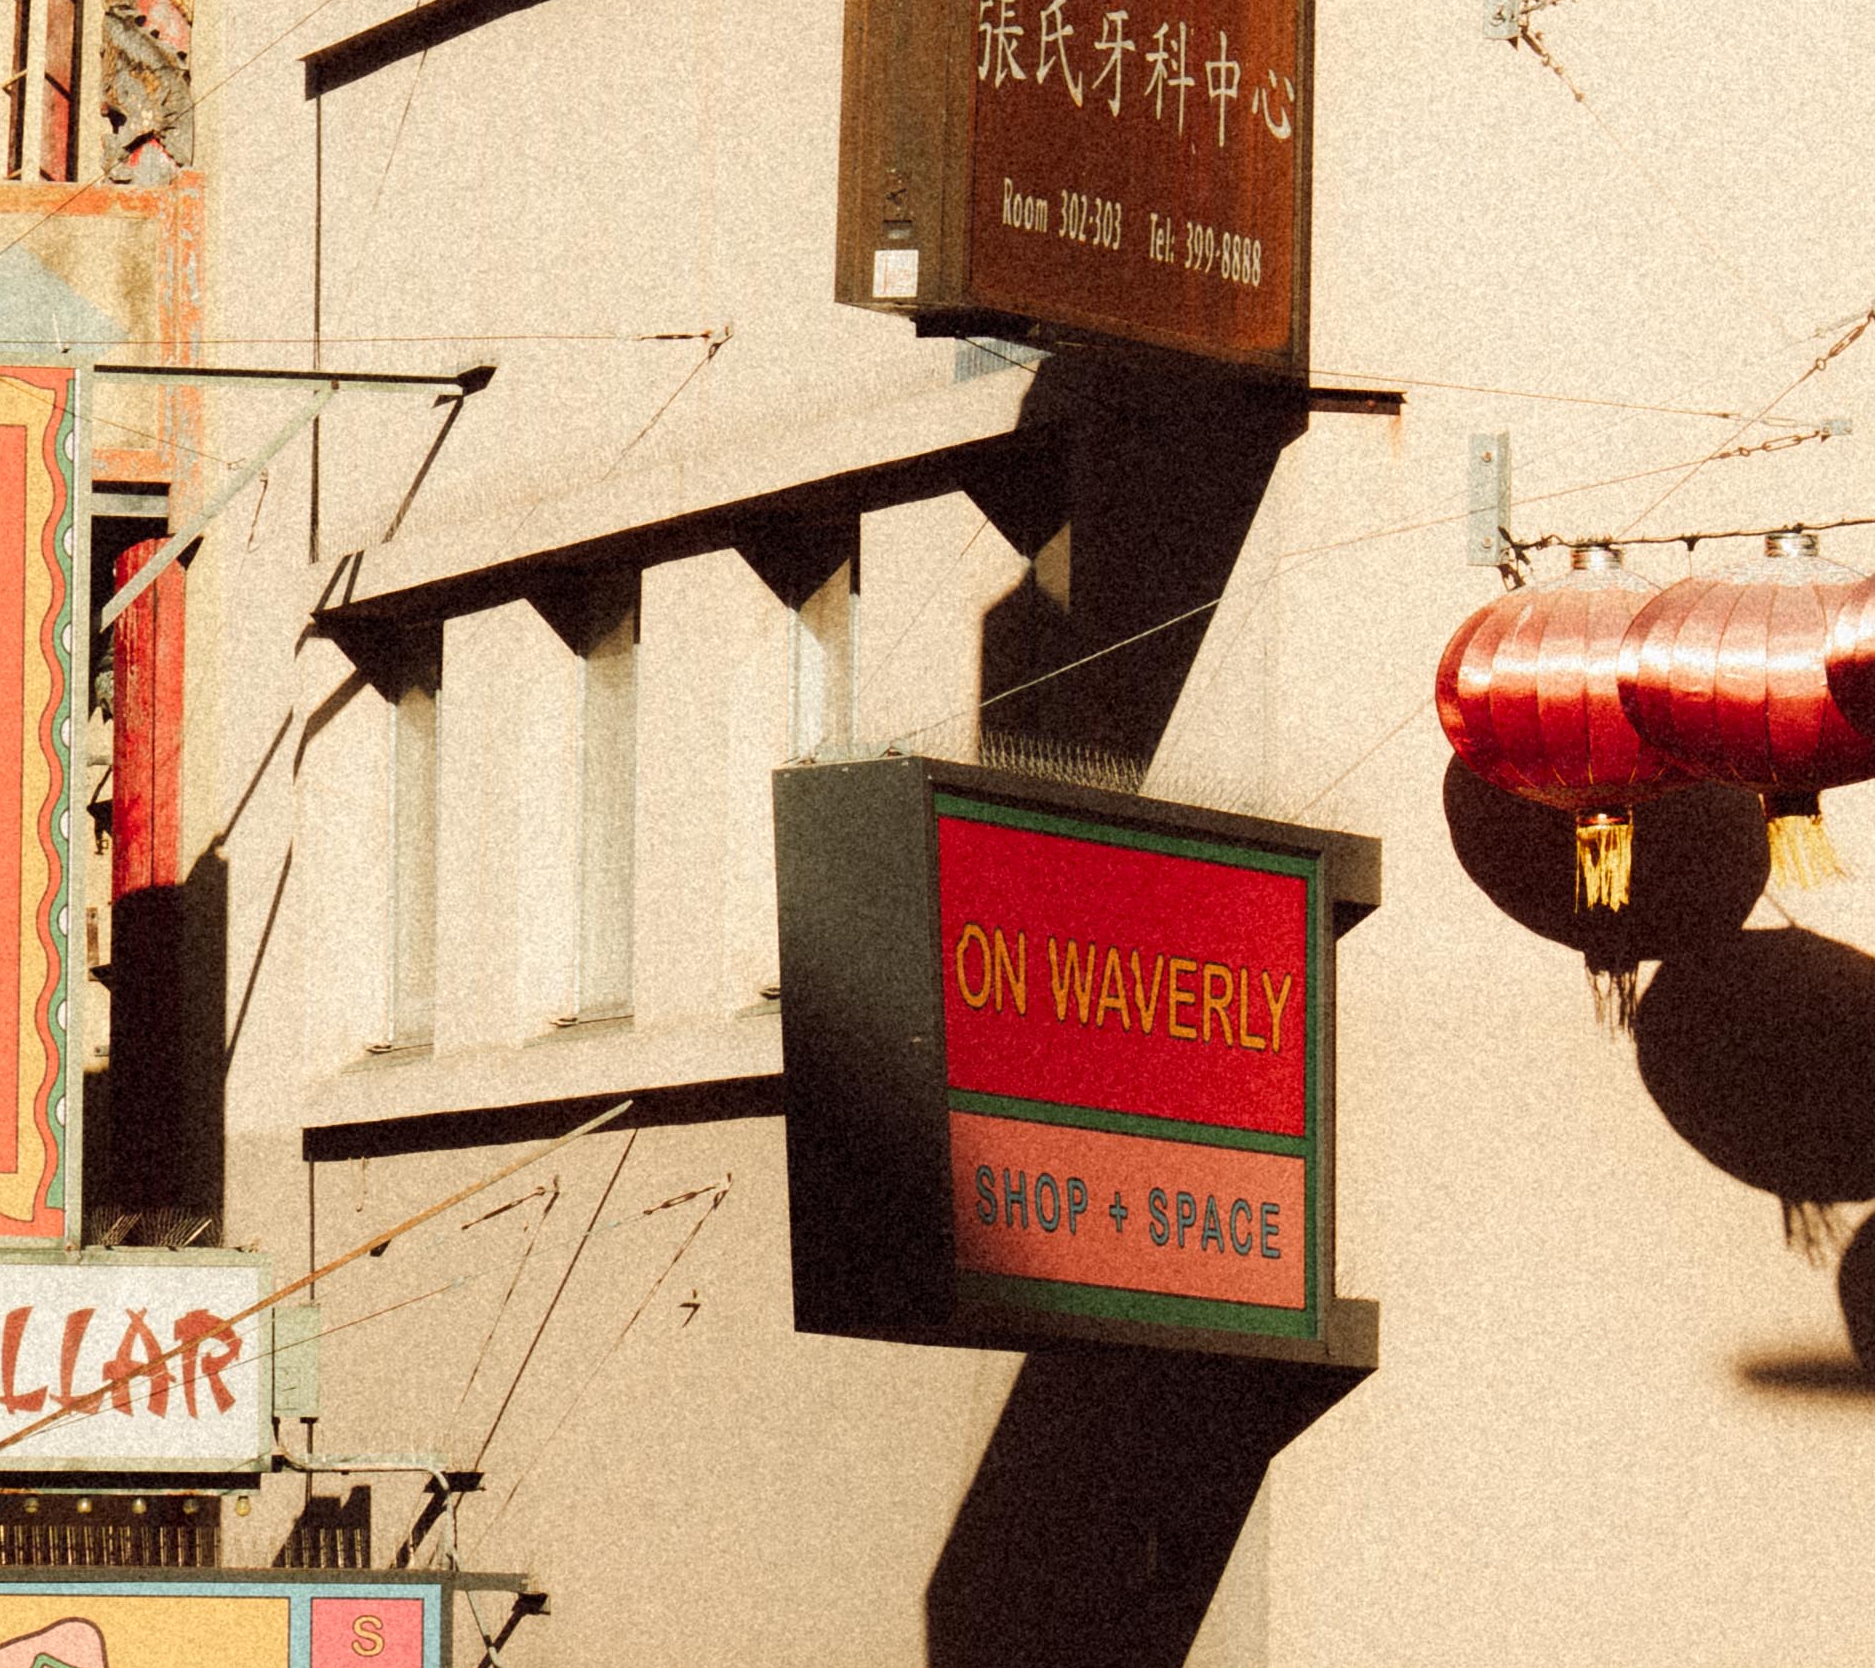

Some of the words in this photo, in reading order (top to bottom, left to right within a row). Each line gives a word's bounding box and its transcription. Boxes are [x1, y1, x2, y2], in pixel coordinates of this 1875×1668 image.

[1002, 178, 1049, 234] Room
[1149, 212, 1176, 264] Tel:
[956, 922, 1027, 1017] ON
[1047, 936, 1292, 1054] WAVERLY
[975, 1165, 1089, 1235] SHOP
[1148, 1187, 1282, 1260] SPACE
